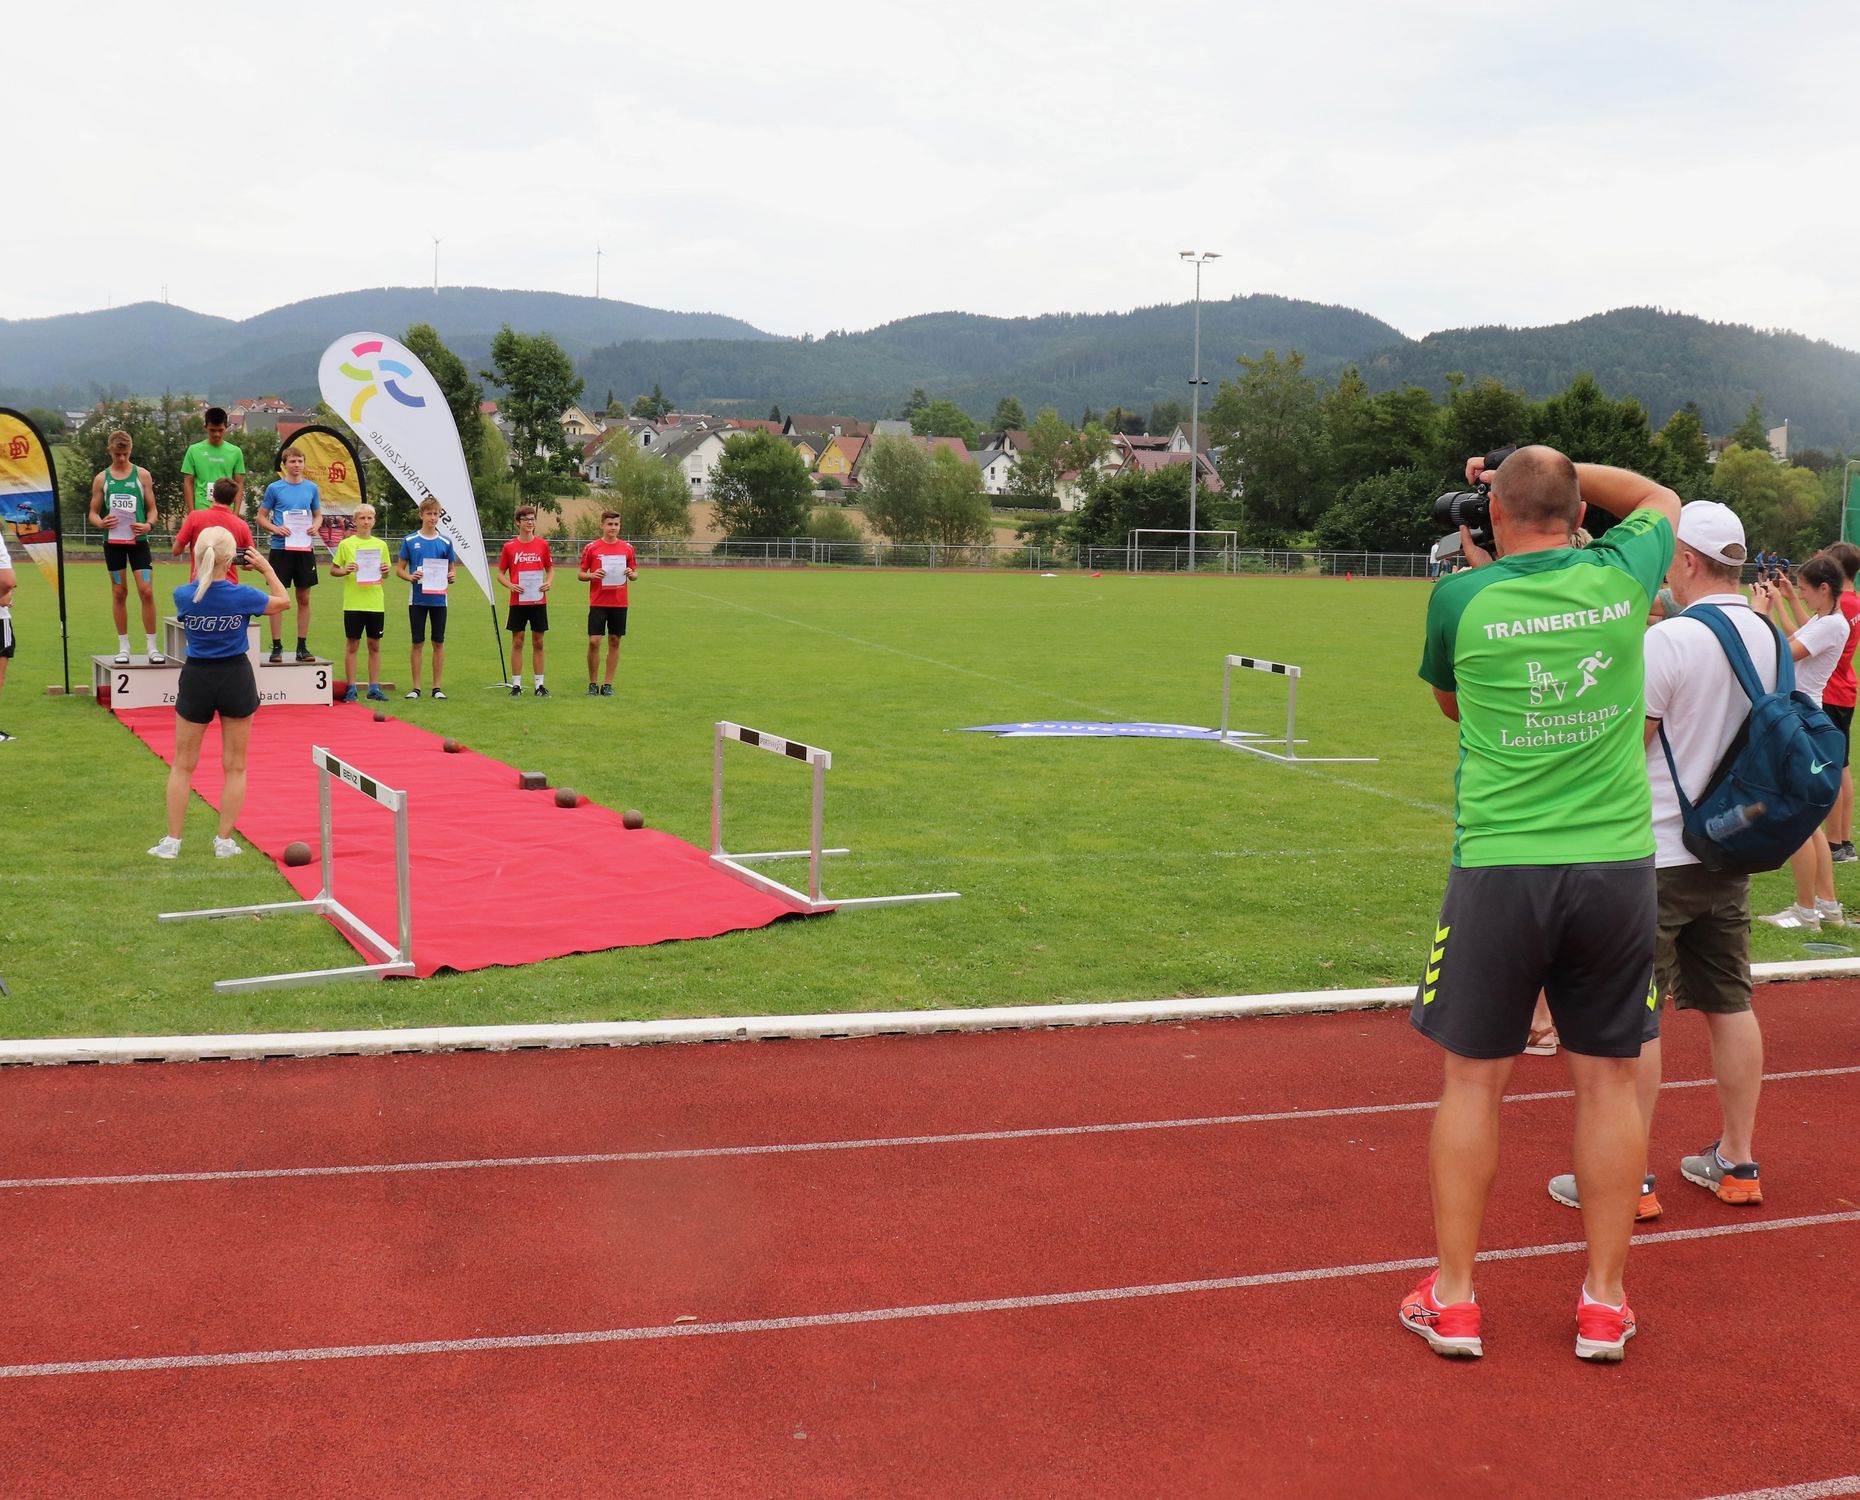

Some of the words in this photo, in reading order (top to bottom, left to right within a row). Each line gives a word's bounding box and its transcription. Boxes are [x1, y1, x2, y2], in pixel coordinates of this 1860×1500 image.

[112, 499, 133, 509] 5305
[218, 615, 243, 632] 78
[1483, 600, 1632, 640] TRAINERTEAM
[117, 673, 130, 694] 2
[315, 670, 328, 690] 3
[162, 692, 178, 703] Ze
[259, 690, 287, 701] bach
[1524, 704, 1620, 729] Konstanz
[1500, 723, 1607, 747] Leichtathl
[342, 768, 358, 785] BENZ
